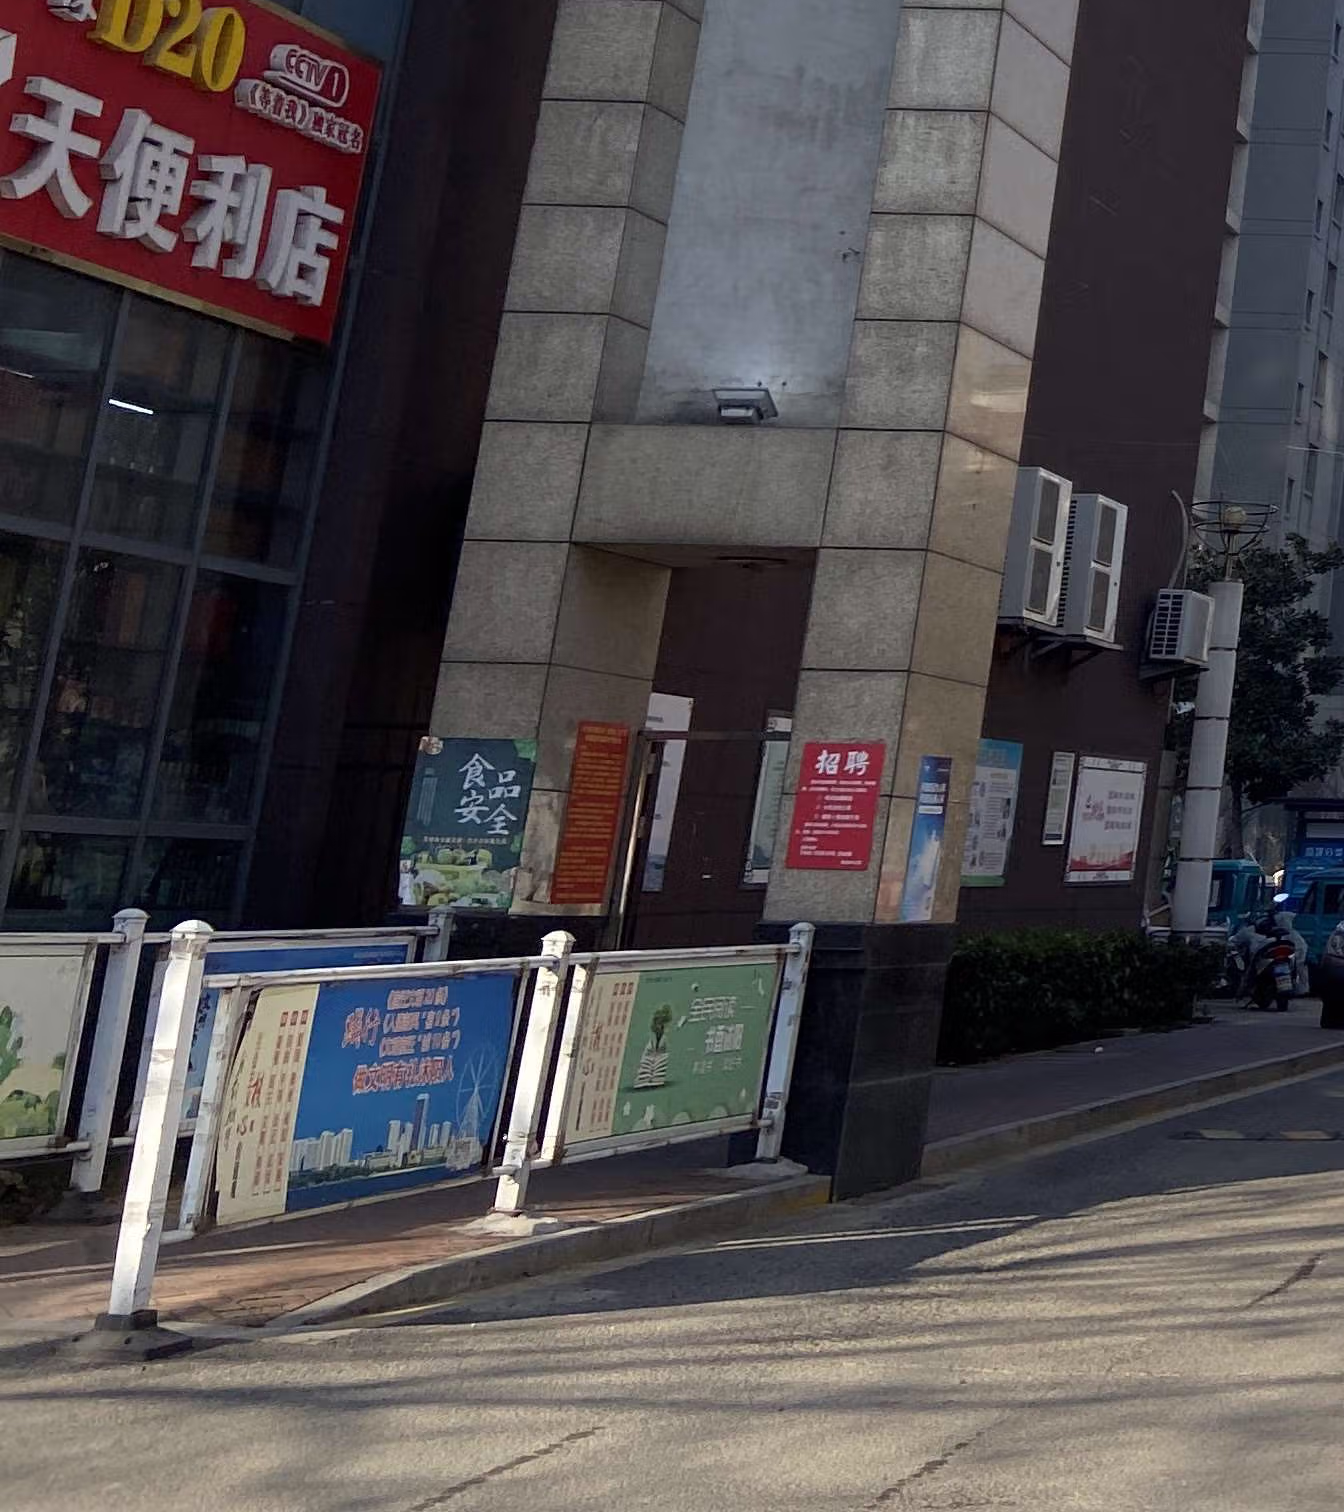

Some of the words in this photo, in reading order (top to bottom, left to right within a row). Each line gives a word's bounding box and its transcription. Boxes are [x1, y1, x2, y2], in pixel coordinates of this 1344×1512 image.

[0, 29, 345, 307] 天便利店
[816, 750, 869, 776] 招聘
